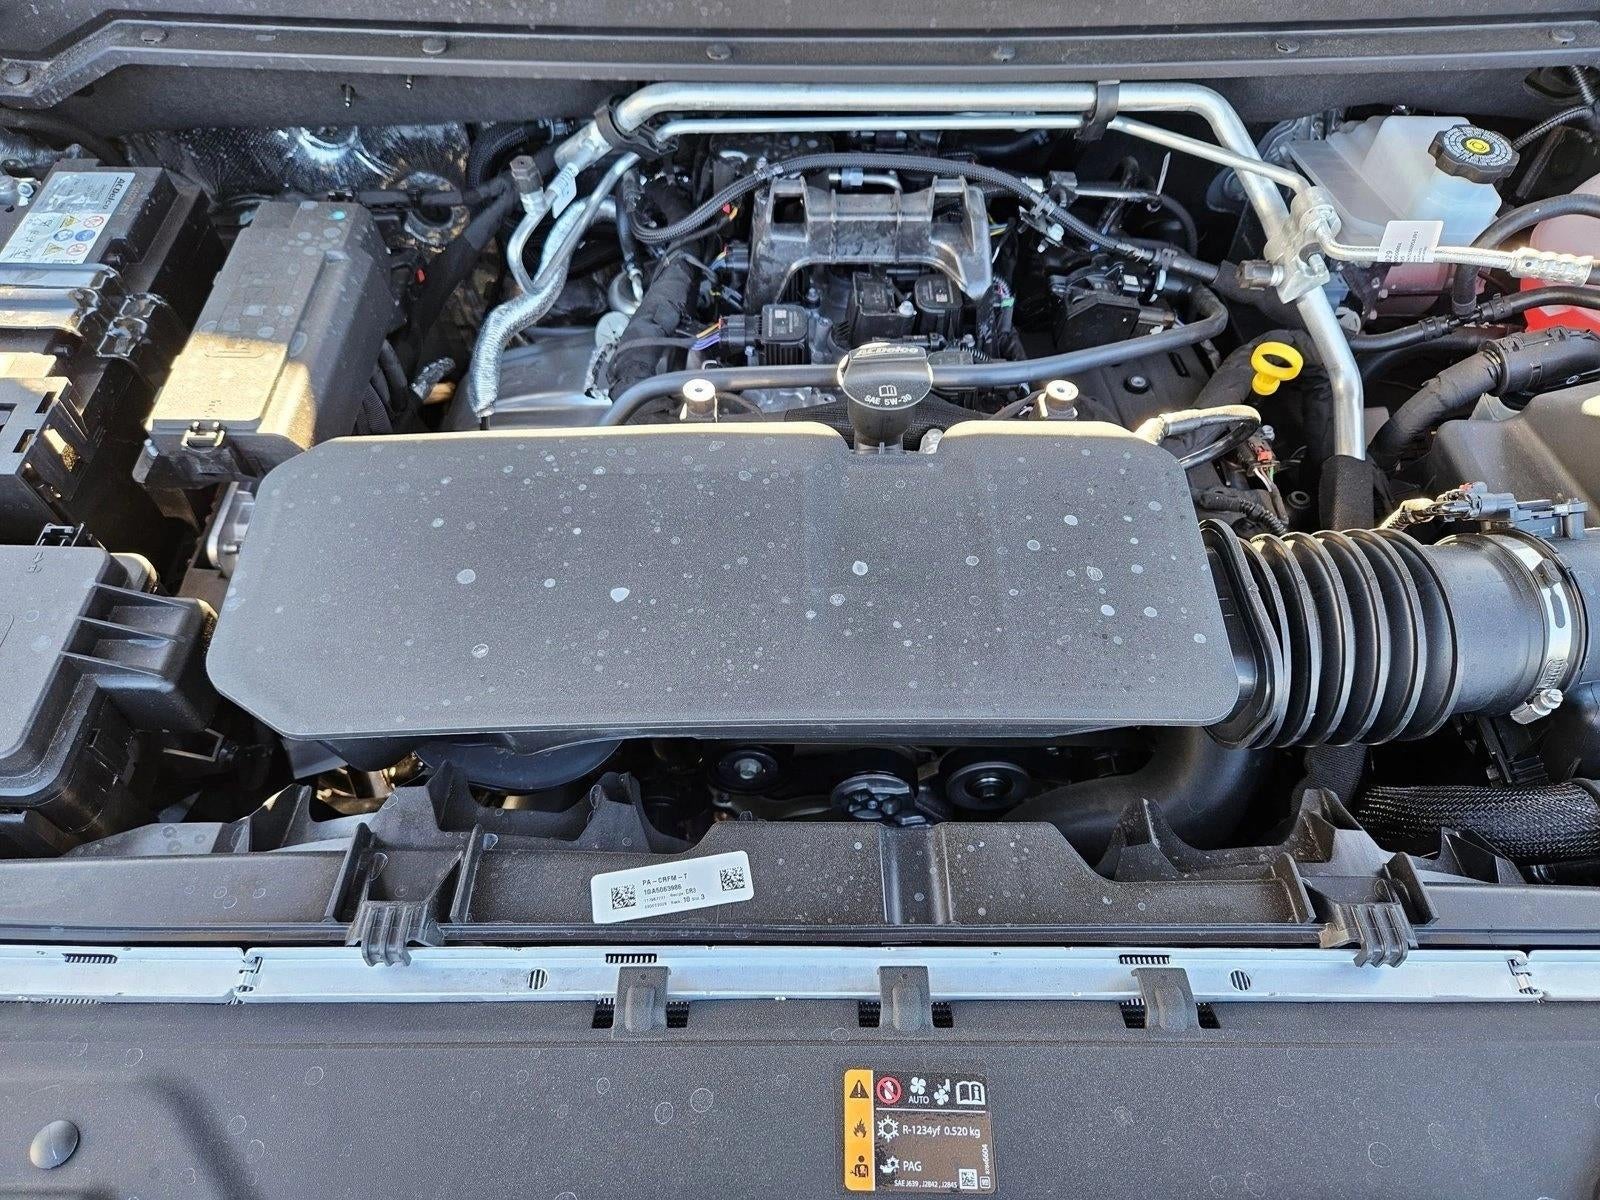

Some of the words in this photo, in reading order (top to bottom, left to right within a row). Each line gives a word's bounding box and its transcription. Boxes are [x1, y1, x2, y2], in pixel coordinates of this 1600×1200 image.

[103, 177, 126, 210] ACDelco
[864, 394, 881, 405] SAE
[908, 1096, 929, 1104] AUTO
[902, 1125, 941, 1137] R-1234yf
[944, 1127, 968, 1136] 0.520
[969, 1126, 981, 1138] kg
[903, 1161, 922, 1172] PAG
[894, 1179, 905, 1187] SAE
